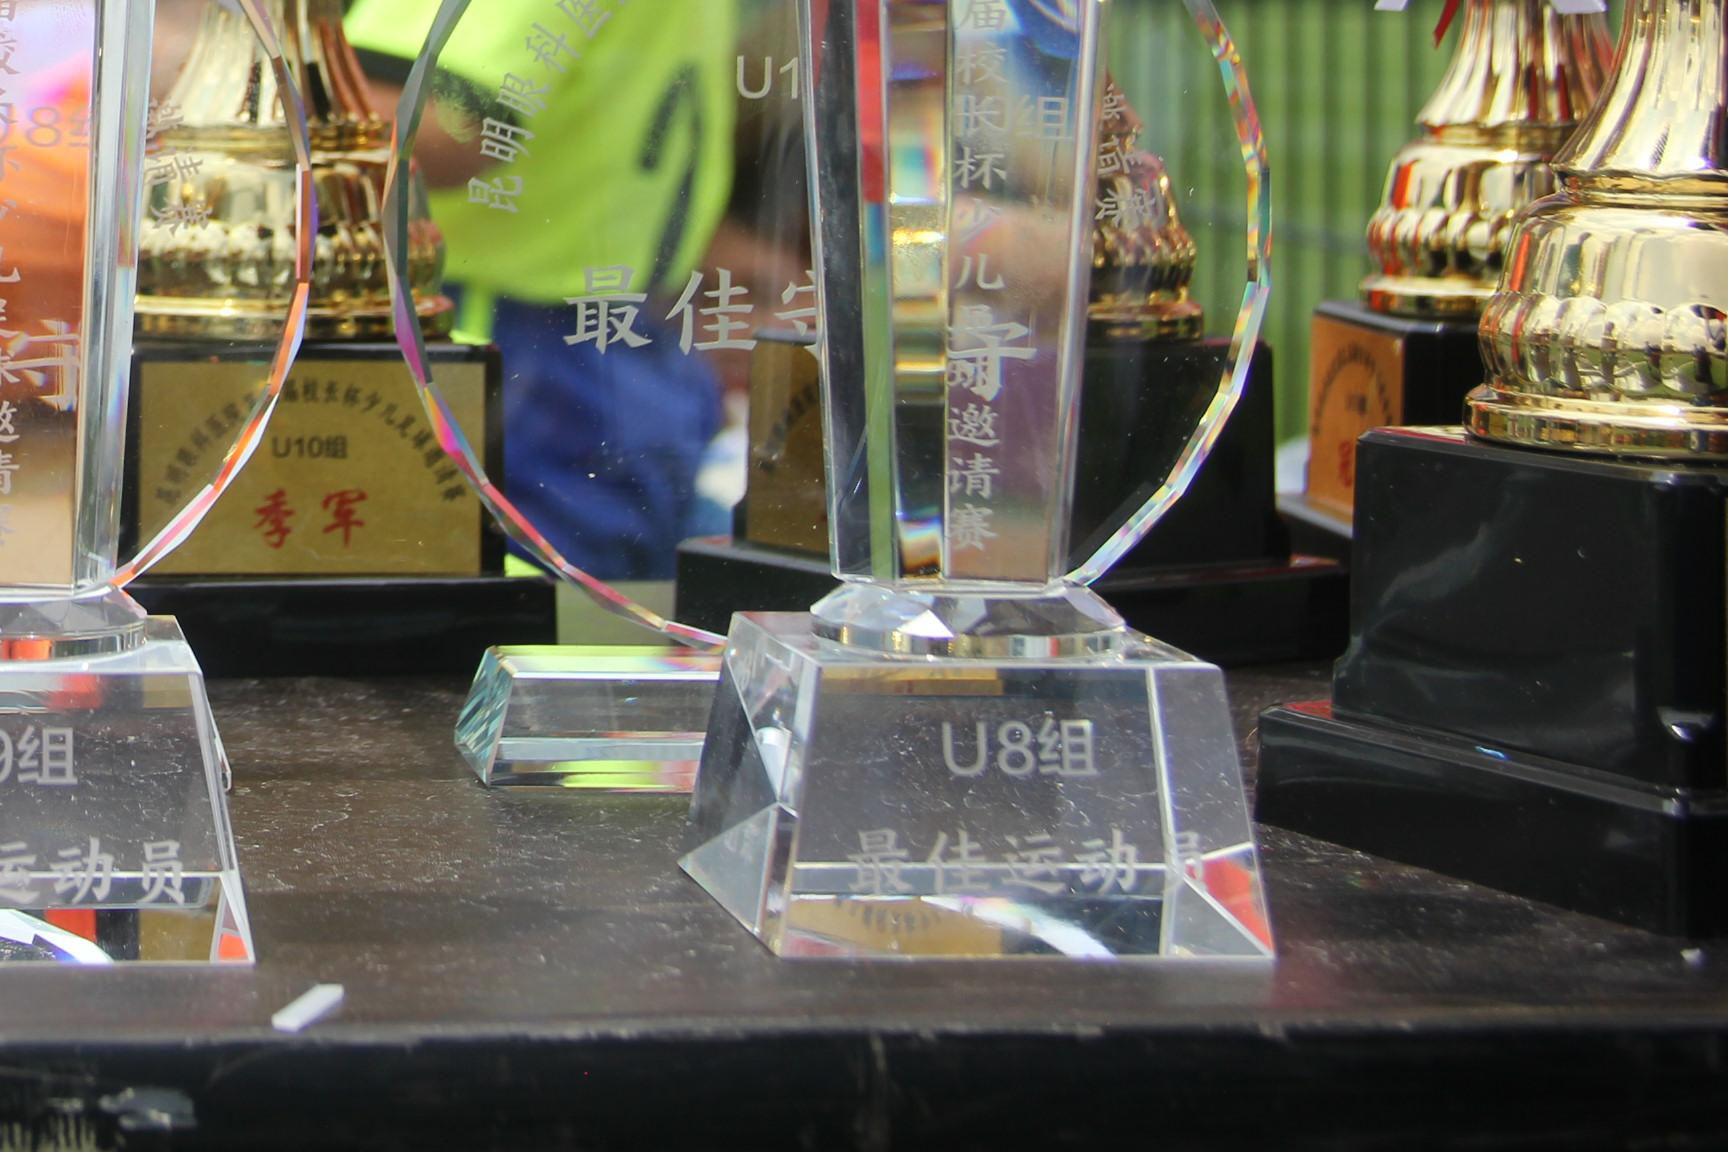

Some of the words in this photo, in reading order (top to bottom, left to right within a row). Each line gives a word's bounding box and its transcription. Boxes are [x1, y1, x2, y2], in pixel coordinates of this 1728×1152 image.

[271, 434, 349, 461] U10组
[253, 487, 369, 549] 季军
[941, 715, 1100, 779] U8组
[845, 826, 1209, 897] 最佳运动员
